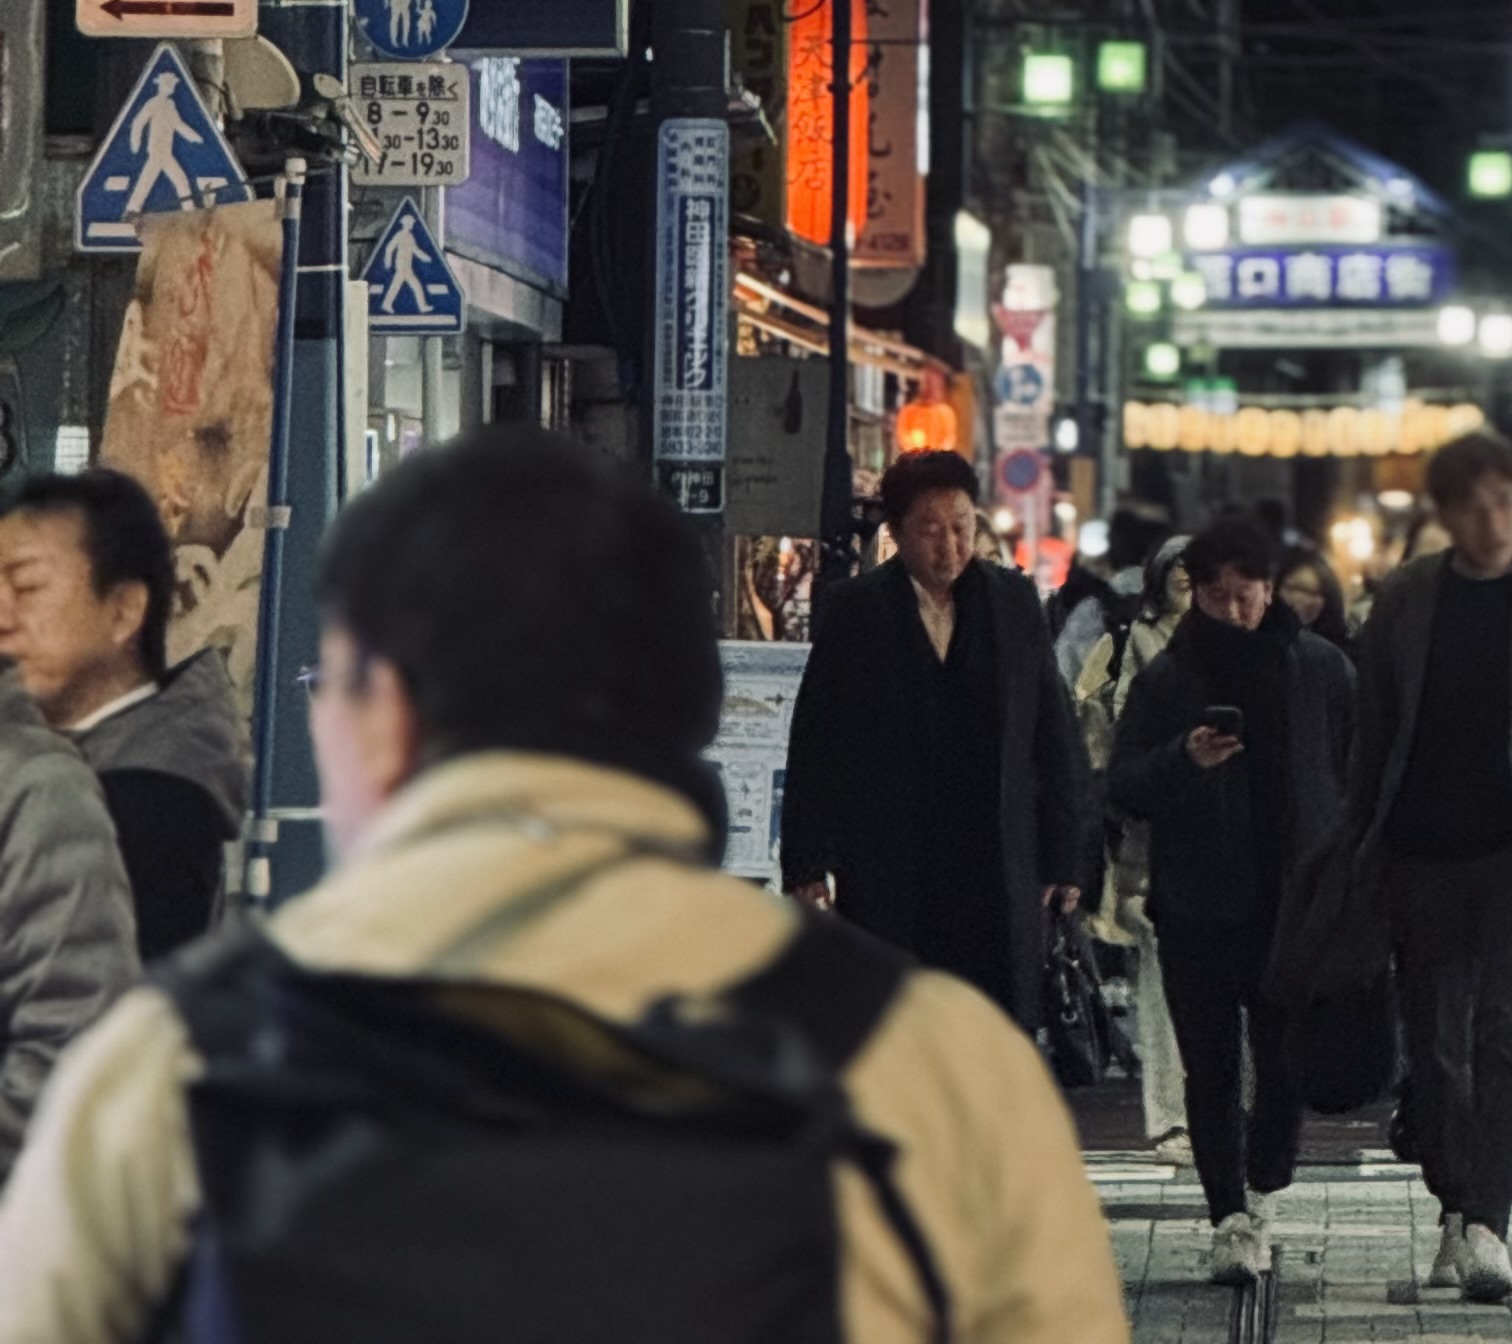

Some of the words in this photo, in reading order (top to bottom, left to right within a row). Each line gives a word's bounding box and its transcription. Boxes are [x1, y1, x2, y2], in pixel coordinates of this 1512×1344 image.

[360, 74, 459, 98] 自転車を除く
